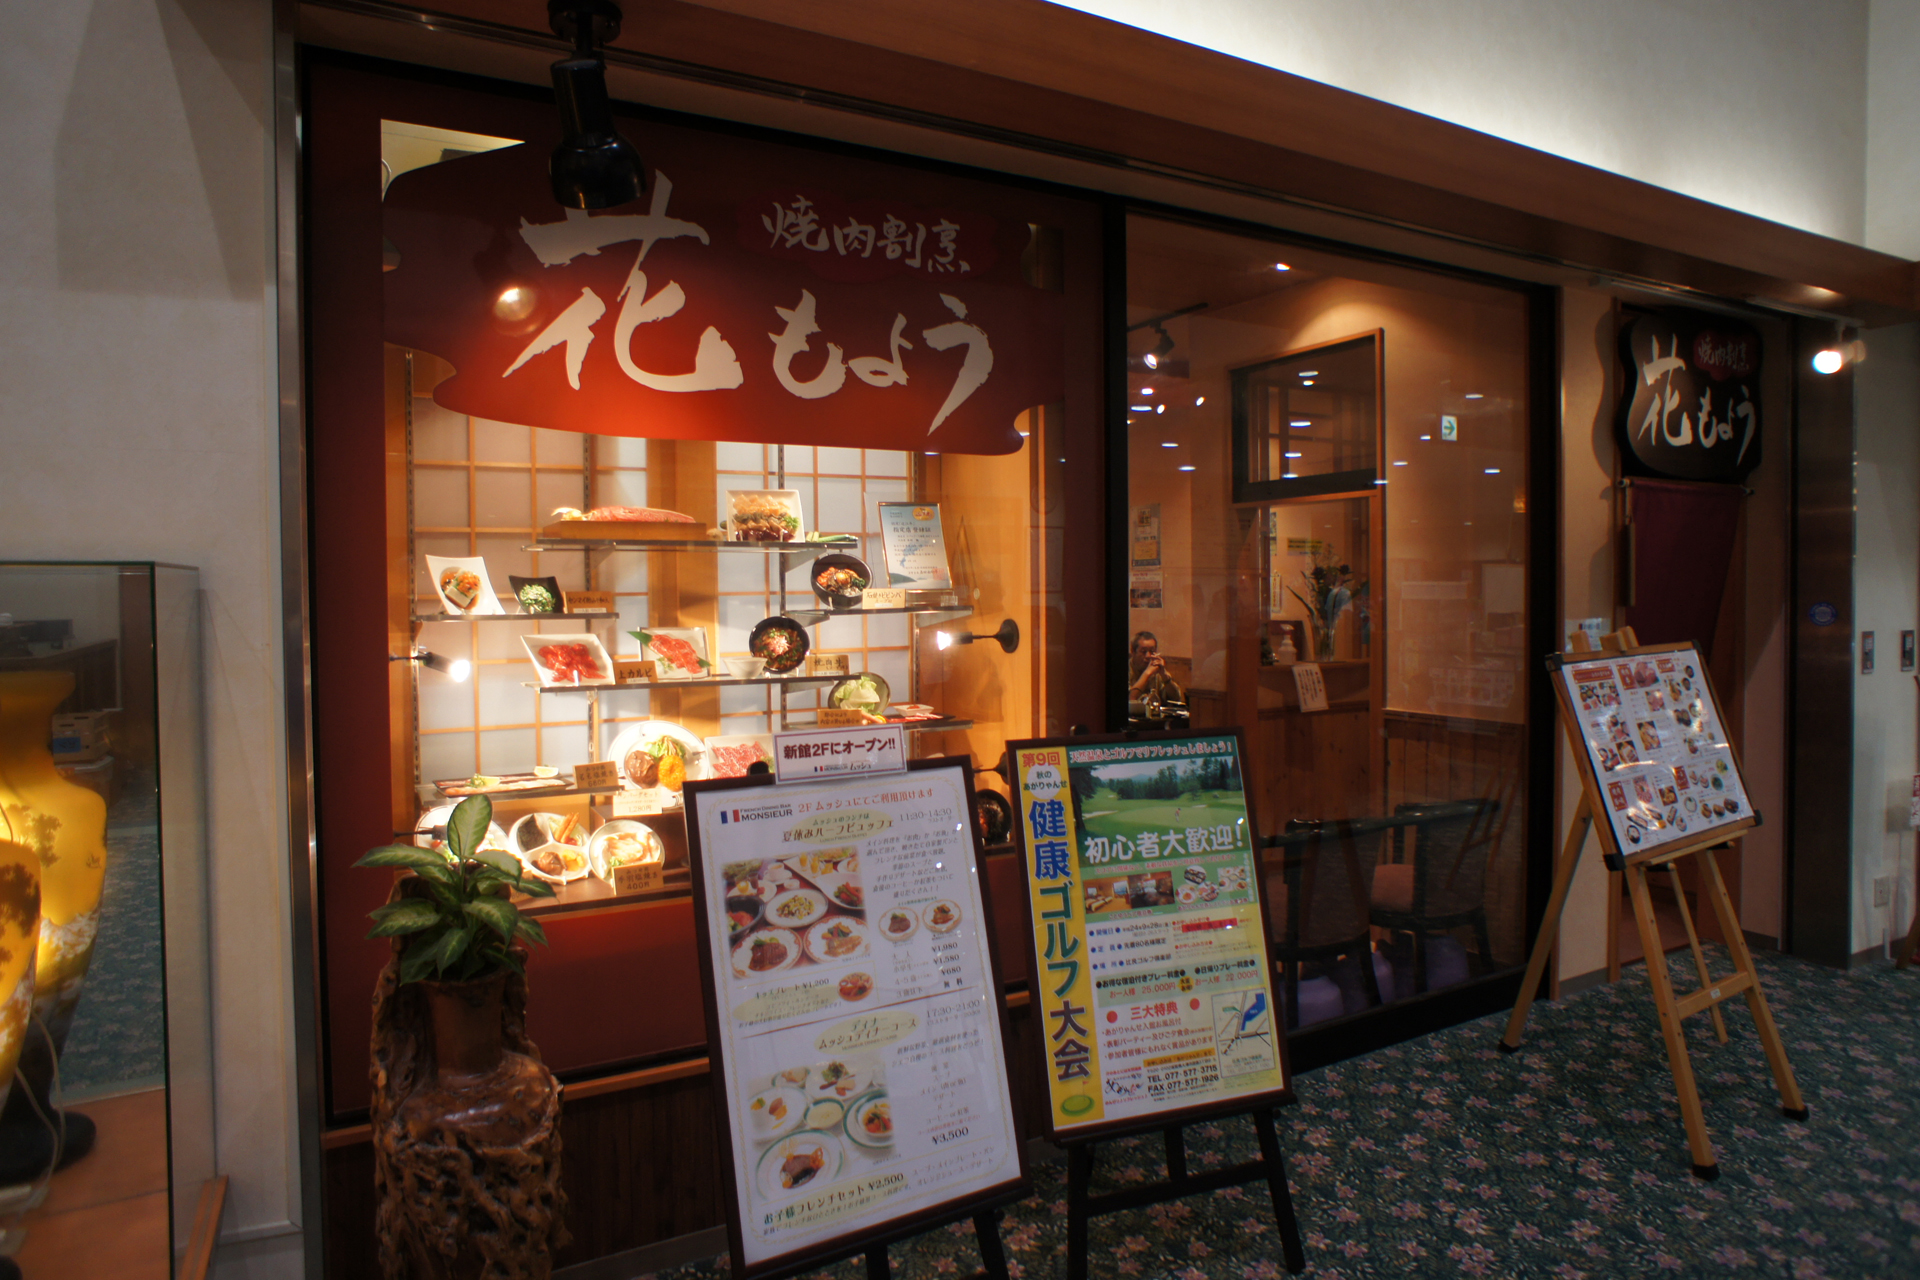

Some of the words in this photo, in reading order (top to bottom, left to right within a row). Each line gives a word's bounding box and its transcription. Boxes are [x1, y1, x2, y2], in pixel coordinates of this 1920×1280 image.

[762, 195, 969, 274] 焼肉割烹
[502, 169, 994, 436] 花もよう
[1638, 333, 1756, 467] 花もよう
[783, 738, 896, 760] 新館2Fにオープン!!
[1021, 751, 1061, 767] 第9回
[1023, 780, 1068, 791] あがりゃんせ
[1036, 771, 1052, 780] 秋の
[798, 802, 813, 813] 2F
[815, 788, 934, 811] ムッシュにてご利用頂けます
[741, 808, 793, 822] MONSIEUR
[812, 813, 870, 826] ムッシュのランチは
[782, 819, 894, 843] 夏休みハーフビュッフェ
[1029, 799, 1091, 1082] 健康ゴルフ大会
[802, 978, 830, 990] ¥1,200
[1195, 975, 1220, 986] お一人様
[1110, 988, 1136, 999] お一人様
[1130, 1000, 1179, 1021] 三大特典
[818, 1018, 917, 1050] ムッシュディナーコース
[851, 1017, 888, 1032] ディナー
[931, 1126, 969, 1145] ¥3,500
[763, 1184, 865, 1225] お子様フレンチセット
[868, 1172, 904, 1191] ¥2,500
